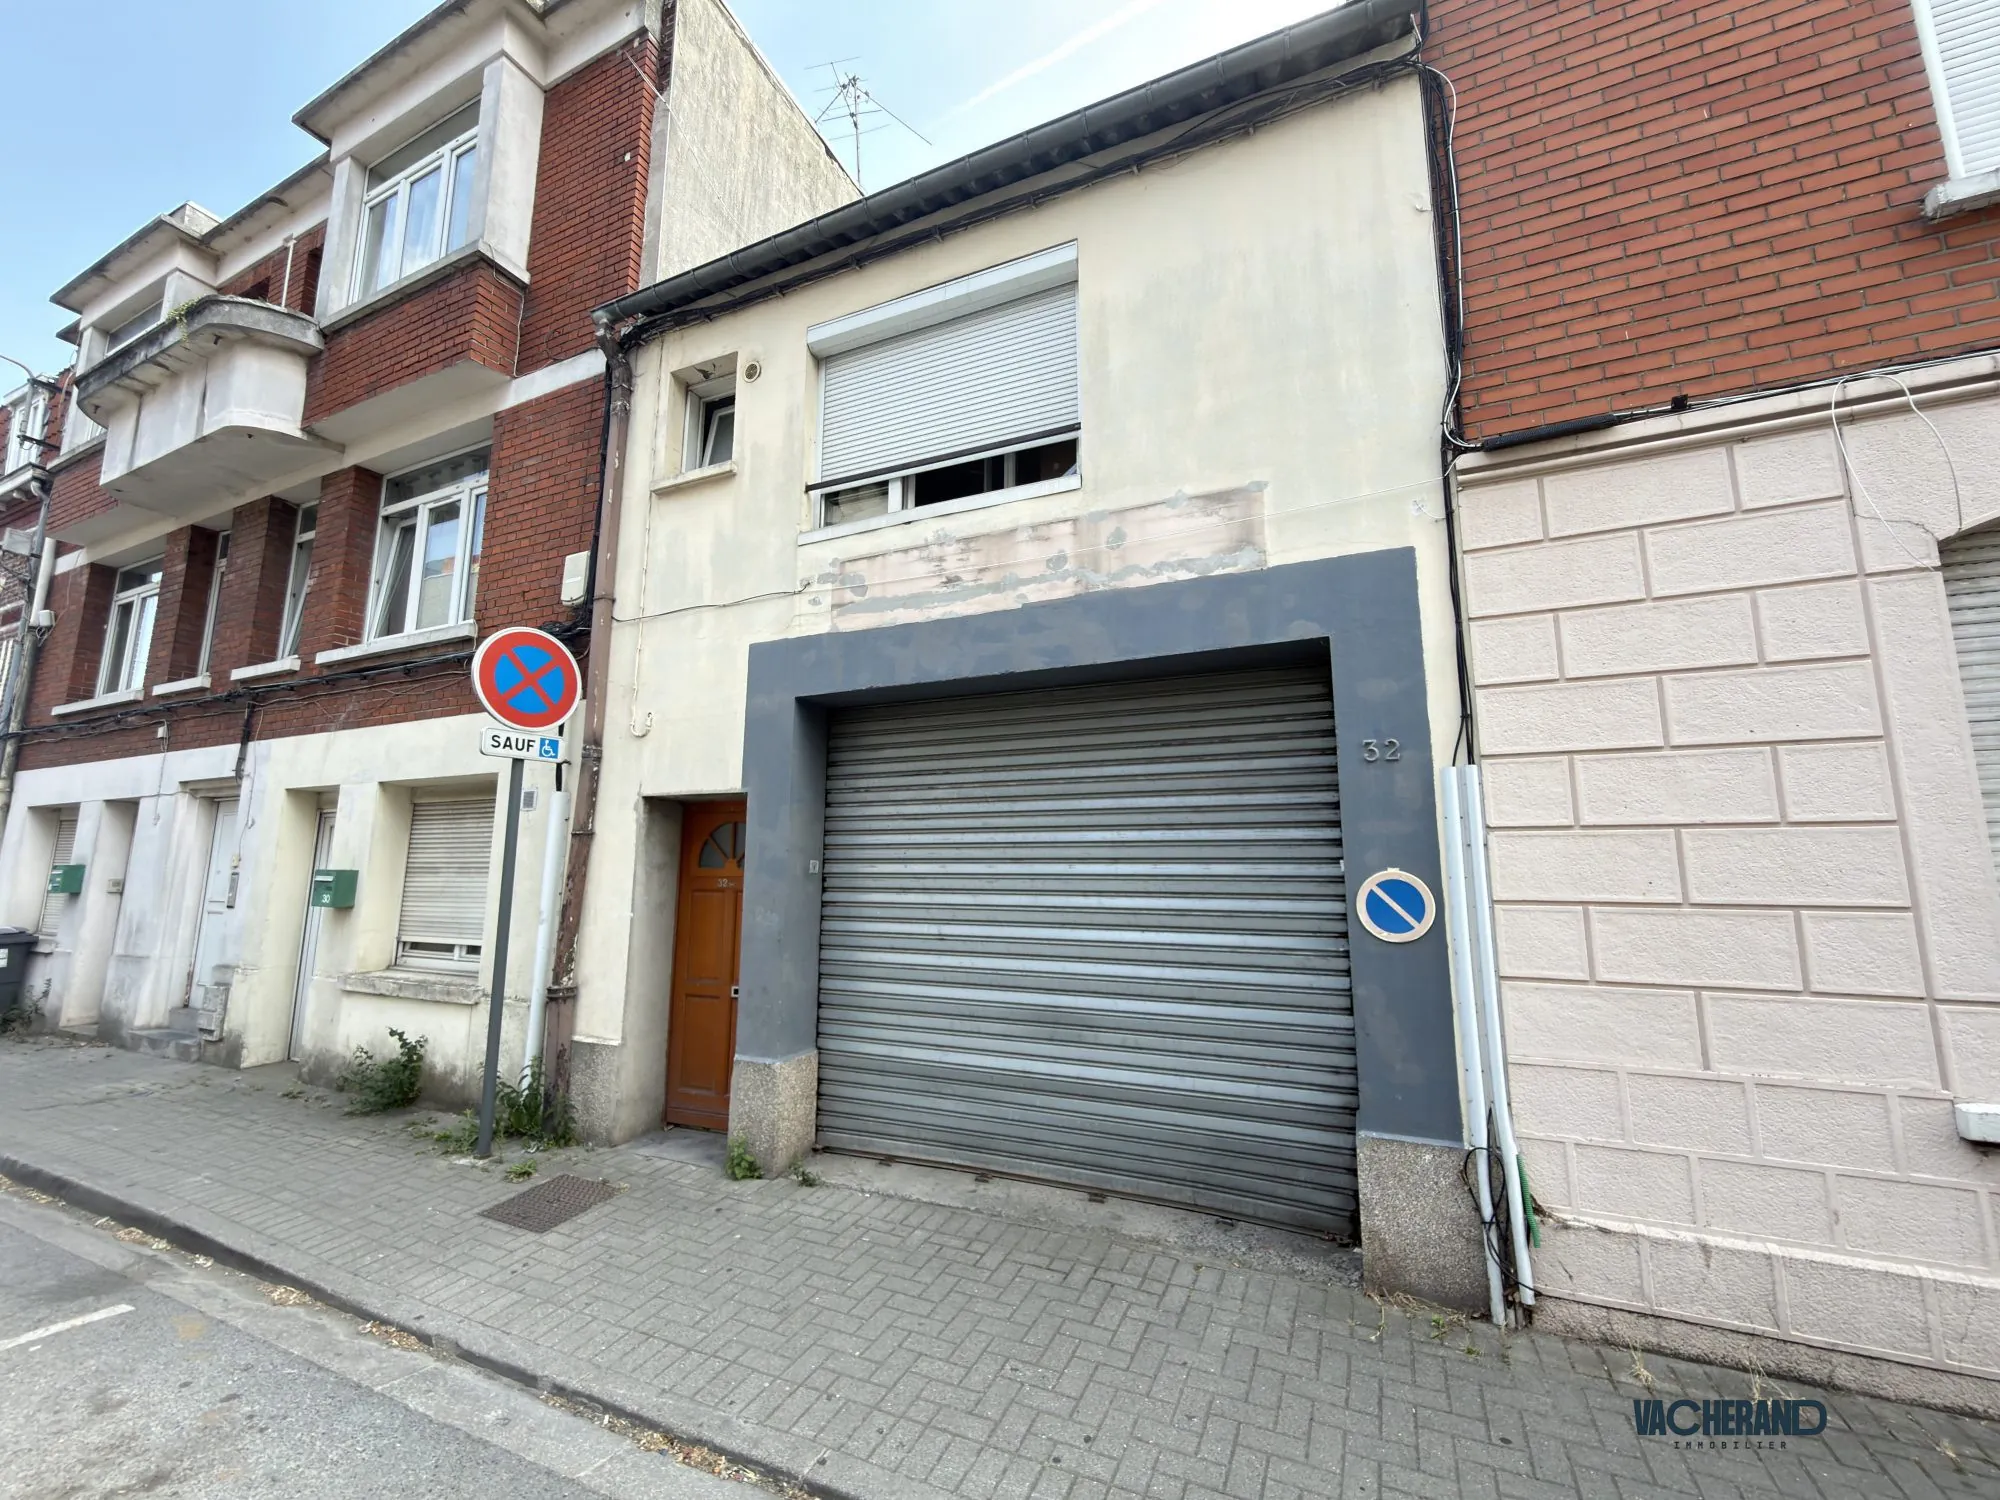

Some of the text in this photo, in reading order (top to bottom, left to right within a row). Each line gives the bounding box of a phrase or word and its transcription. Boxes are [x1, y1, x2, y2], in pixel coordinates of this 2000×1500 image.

[491, 735, 536, 753] SAUF
[1362, 738, 1400, 761] 32
[322, 894, 331, 903] 30
